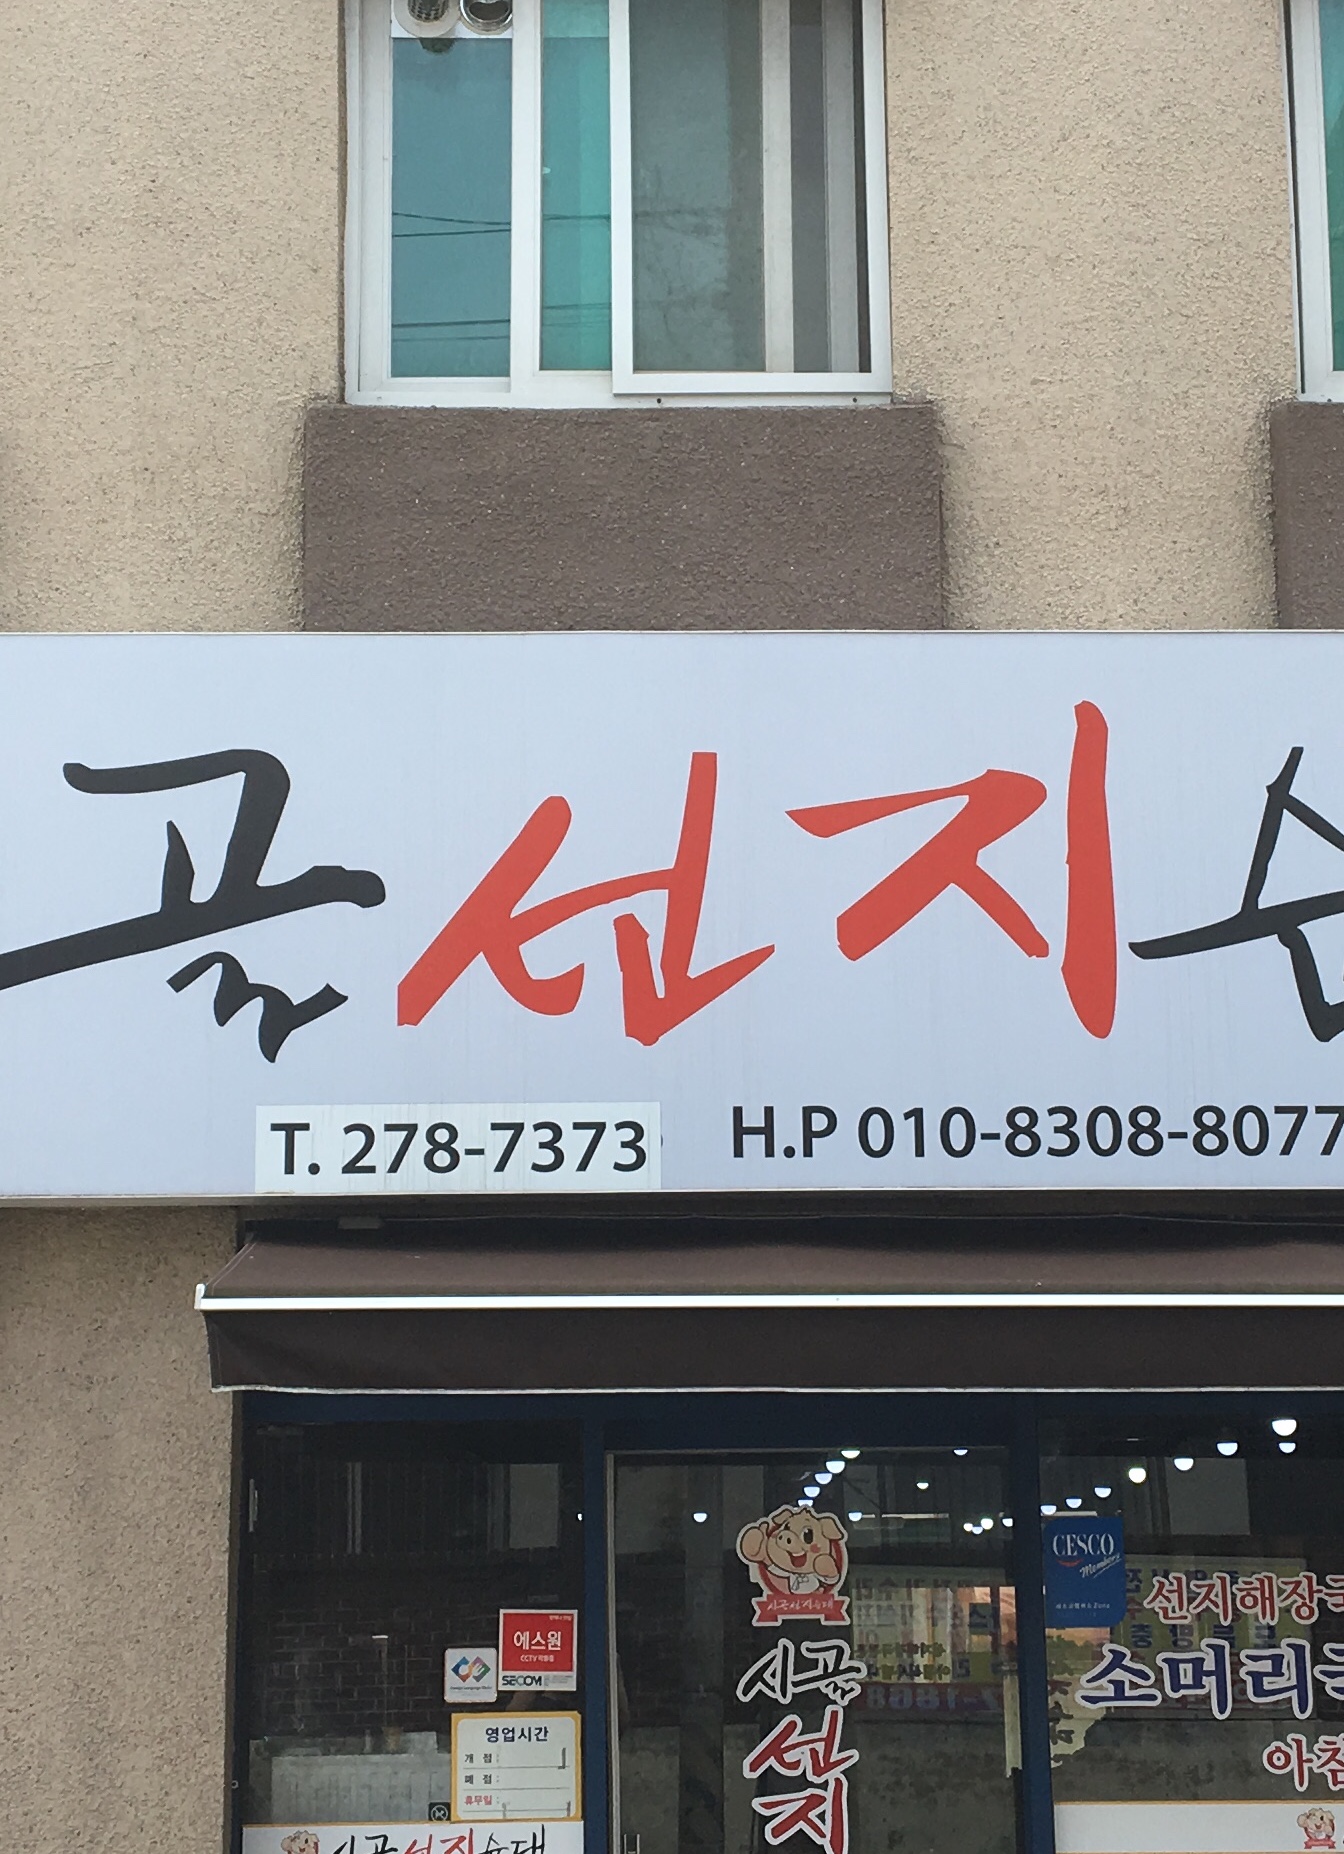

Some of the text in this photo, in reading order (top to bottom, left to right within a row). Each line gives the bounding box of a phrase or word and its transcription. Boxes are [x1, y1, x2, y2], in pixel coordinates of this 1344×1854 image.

[732, 1105, 838, 1160] H.P
[271, 1121, 648, 1175] T. 278-7373
[1052, 1532, 1115, 1557] CESCO
[513, 1630, 562, 1651] 에스원
[485, 1726, 549, 1743] 영업시간
